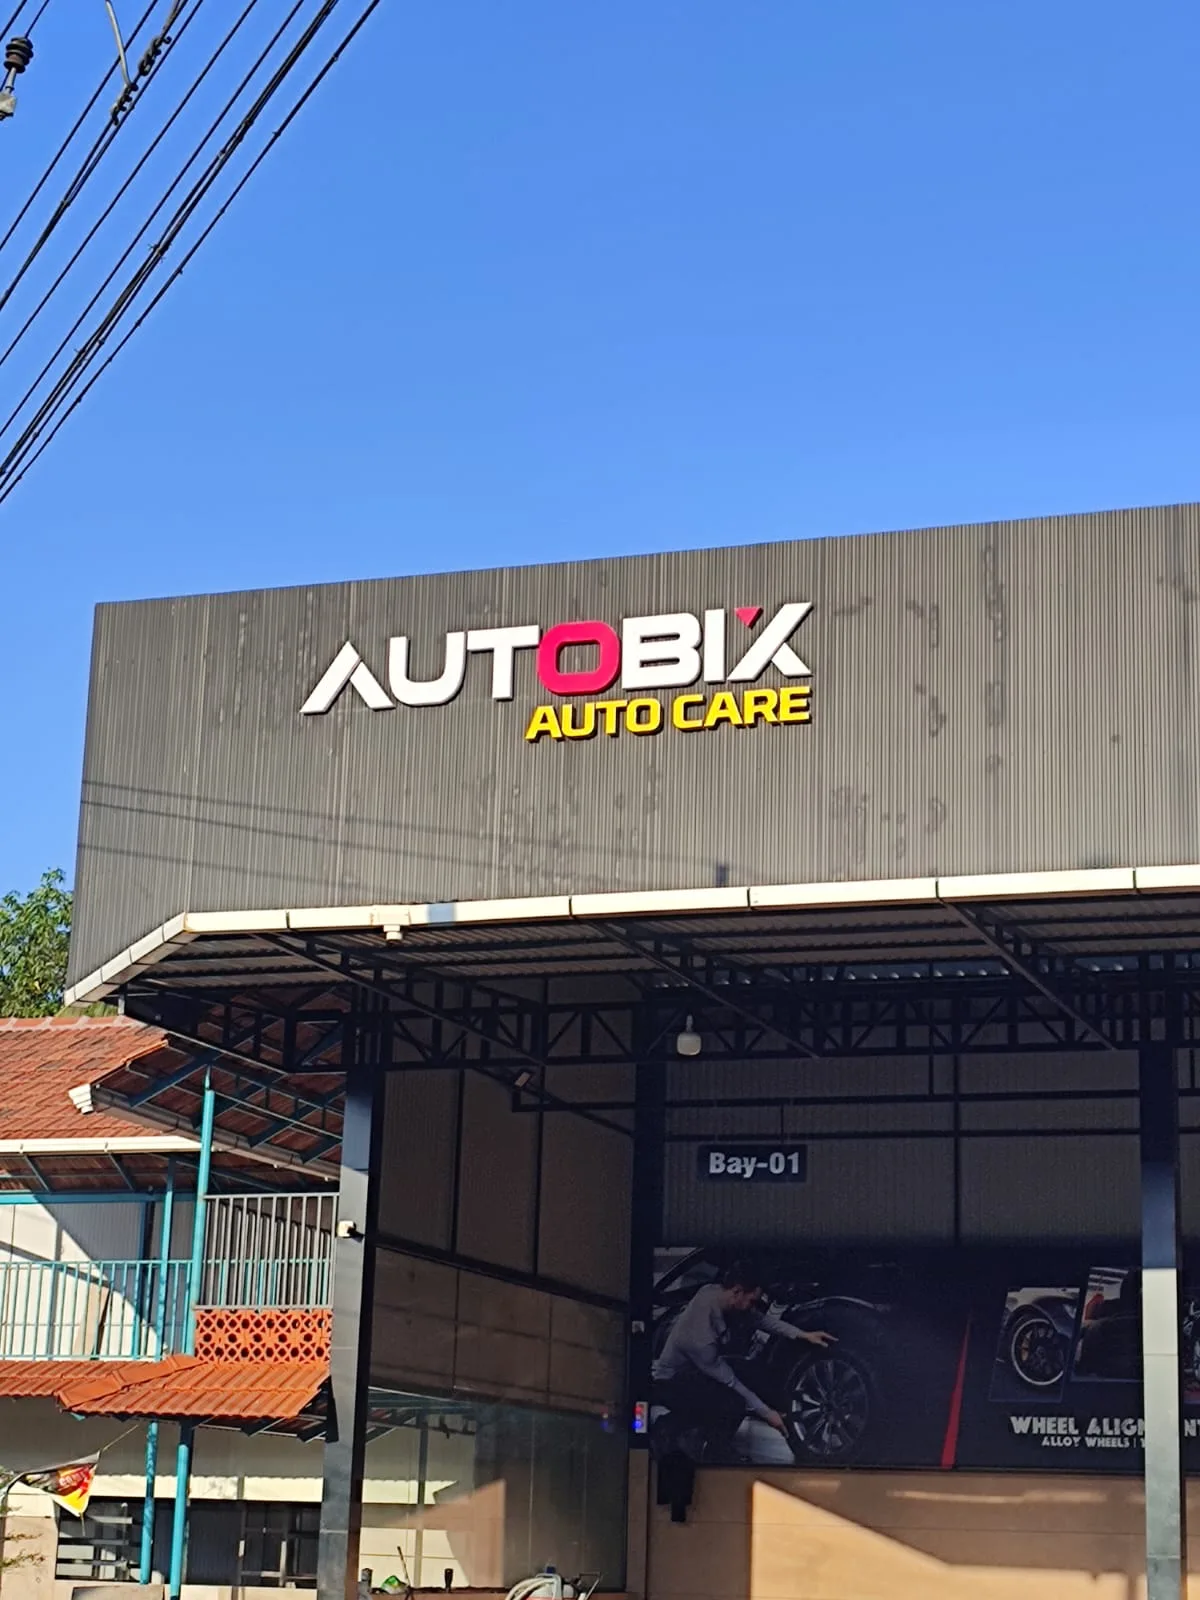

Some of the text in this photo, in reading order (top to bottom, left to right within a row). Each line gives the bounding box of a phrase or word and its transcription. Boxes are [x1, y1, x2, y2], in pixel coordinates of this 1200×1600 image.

[300, 602, 813, 714] AUTOBIX
[526, 686, 812, 741] AUTO CARE
[709, 1152, 799, 1178] Bay-01
[1010, 1416, 1079, 1435] WHEEL
[1041, 1436, 1080, 1448] ALLOY
[1085, 1437, 1130, 1448] WHEELS
